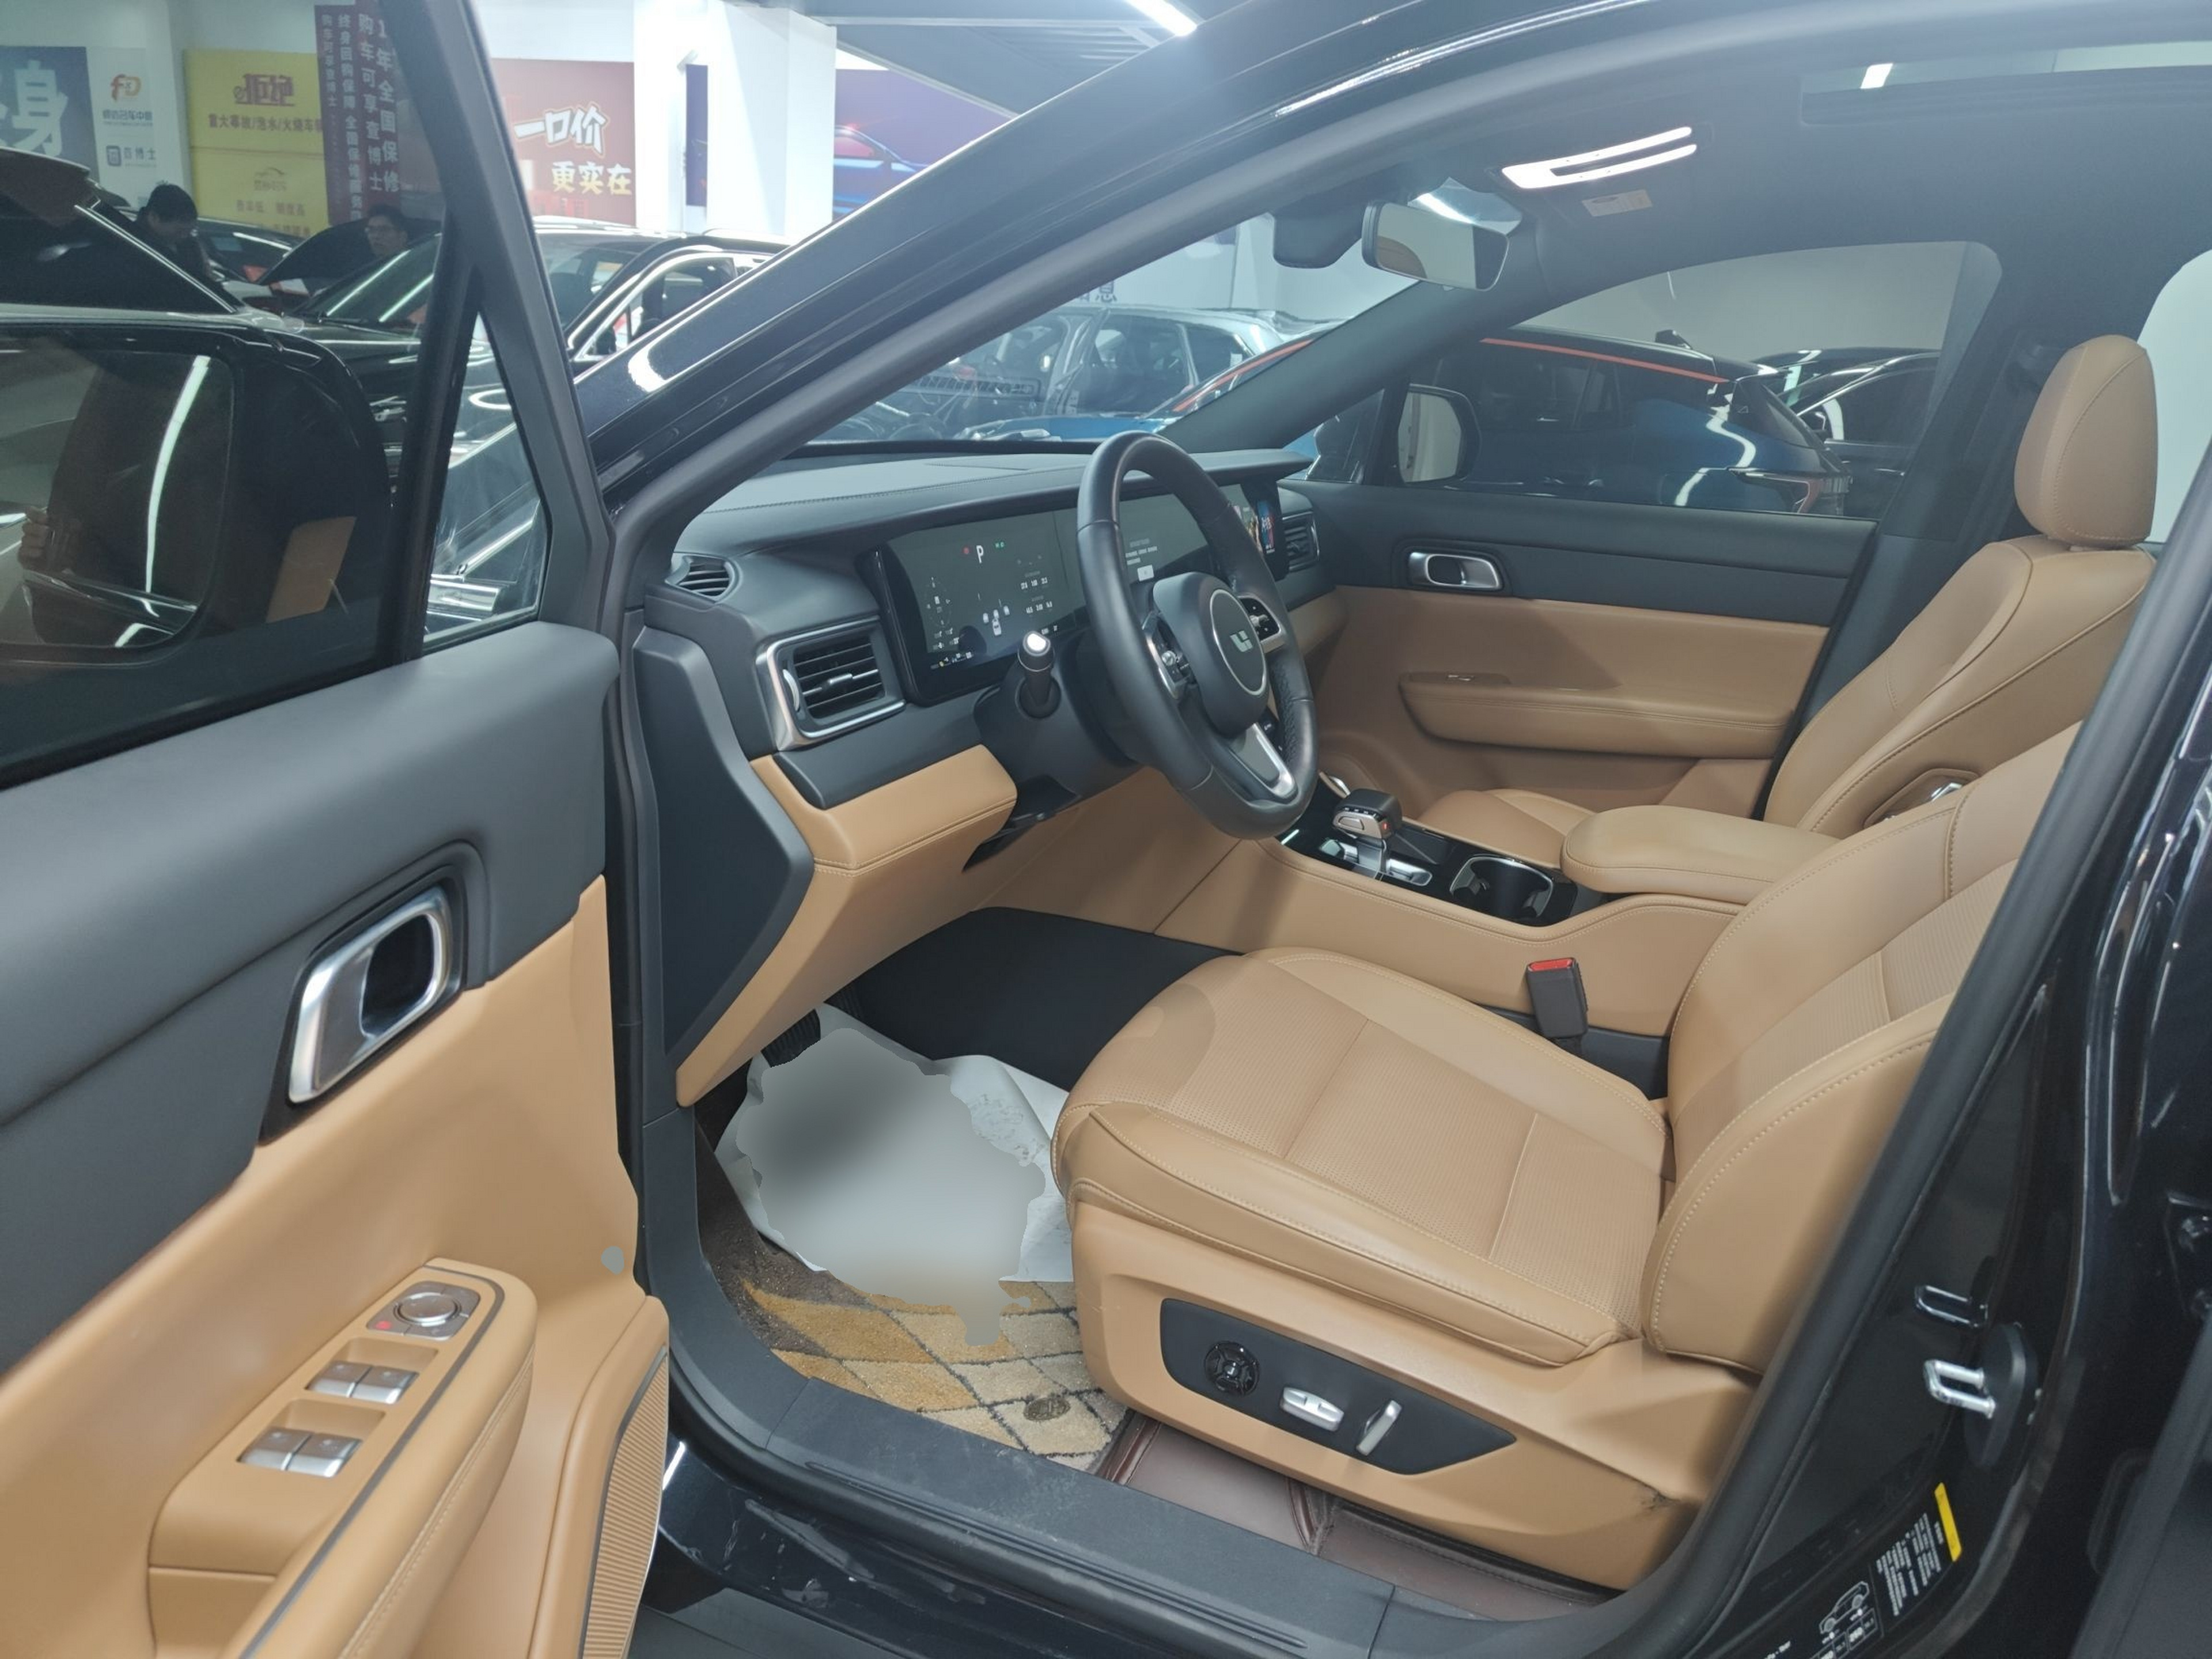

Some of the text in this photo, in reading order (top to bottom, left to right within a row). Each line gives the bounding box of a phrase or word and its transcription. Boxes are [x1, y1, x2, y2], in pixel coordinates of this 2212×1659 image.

[514, 105, 607, 154] 一口价
[551, 161, 632, 195] 更实在
[976, 545, 984, 564] P
